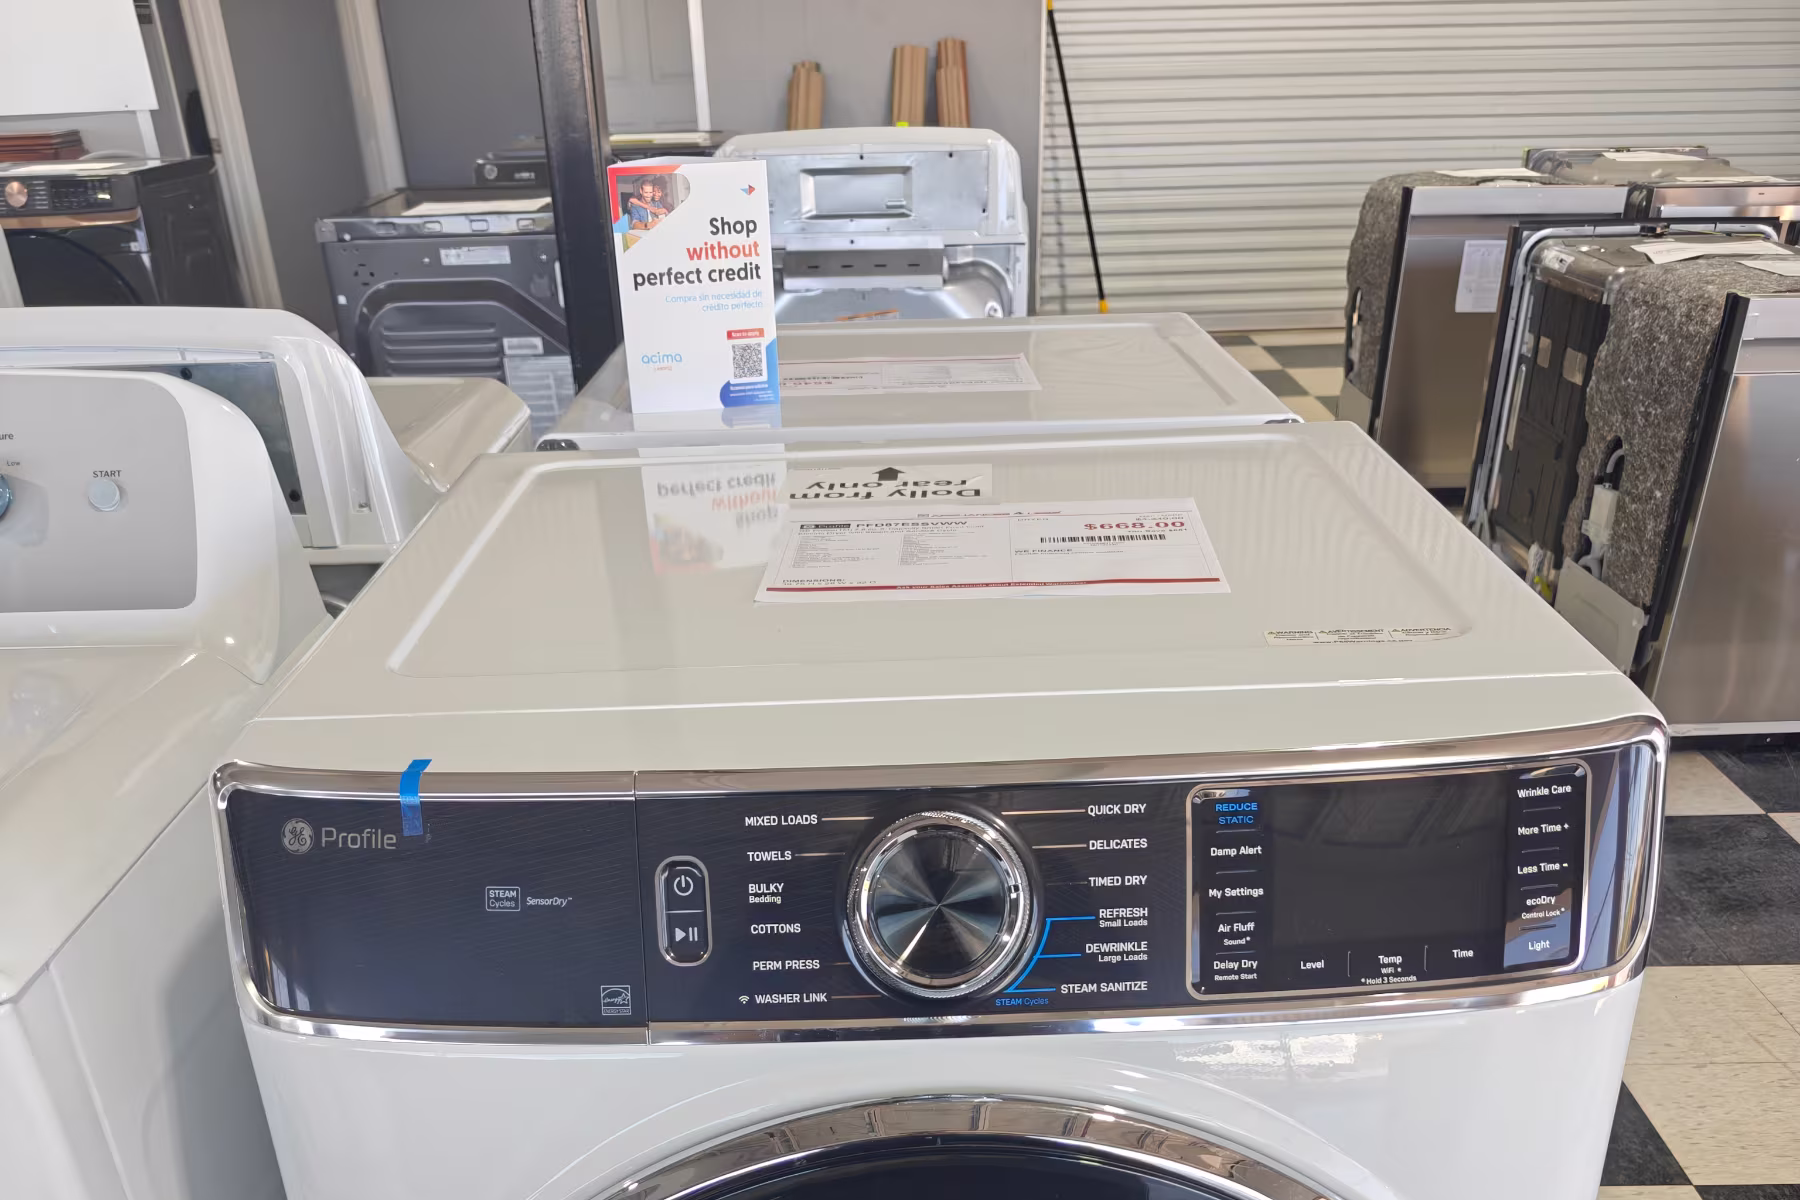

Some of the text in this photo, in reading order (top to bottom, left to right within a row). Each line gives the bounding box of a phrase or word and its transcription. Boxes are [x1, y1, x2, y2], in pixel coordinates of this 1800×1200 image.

[709, 217, 757, 237] Shop
[686, 240, 760, 261] without
[633, 262, 762, 291] perfect credit
[665, 295, 697, 304] Compra
[699, 293, 710, 301] sin
[711, 290, 751, 300] necesidad
[731, 301, 763, 310] perfecto
[641, 352, 683, 364] acima
[92, 469, 122, 478] START
[806, 481, 883, 491] only
[789, 489, 980, 500] Dolly from
[1084, 521, 1185, 530] $668.00
[1517, 785, 1572, 798] Wrinkle Care
[1087, 803, 1147, 817] QUICK DRY
[1215, 802, 1258, 812] REDUCE
[745, 814, 818, 826] MIXED LOADS
[1218, 815, 1254, 825] STATIC
[1518, 826, 1539, 835] More
[1540, 824, 1562, 833] Time
[321, 826, 397, 850] Profile
[1089, 838, 1148, 850] DELICATES
[747, 851, 792, 862] TOWELS
[1210, 845, 1262, 857] Damp Alert
[1517, 865, 1538, 875] Less
[1539, 862, 1560, 872] Time
[1089, 875, 1147, 887] TIMED DRY
[748, 882, 784, 893] BULKY
[1208, 887, 1264, 899] My Settings
[489, 890, 517, 898] STEAM
[749, 894, 782, 904] Bedding
[489, 899, 516, 908] Cycles
[1526, 895, 1556, 906] ecoDry
[1099, 907, 1148, 919] REFRESH
[1521, 909, 1561, 919] Control Lock
[750, 923, 801, 934] COTTONS
[1099, 918, 1148, 928] Small Loads
[1218, 922, 1255, 933] Air Fluff
[1086, 941, 1148, 953] DEWRINKLE
[1223, 938, 1246, 946] Sound
[1528, 940, 1550, 951] Light
[1098, 953, 1148, 964] Large Loads
[1452, 949, 1474, 958] Time
[752, 959, 820, 971] PERM PRESS
[1213, 959, 1258, 970] Delay Dry
[1300, 960, 1325, 969] Level
[1378, 955, 1403, 965] Temp
[1366, 975, 1417, 985] Hold 3 Seconds
[1060, 981, 1148, 994] STEAM SANITIZE
[755, 992, 828, 1004] WASHER LINK
[995, 997, 1049, 1006] STEAM Cycles
